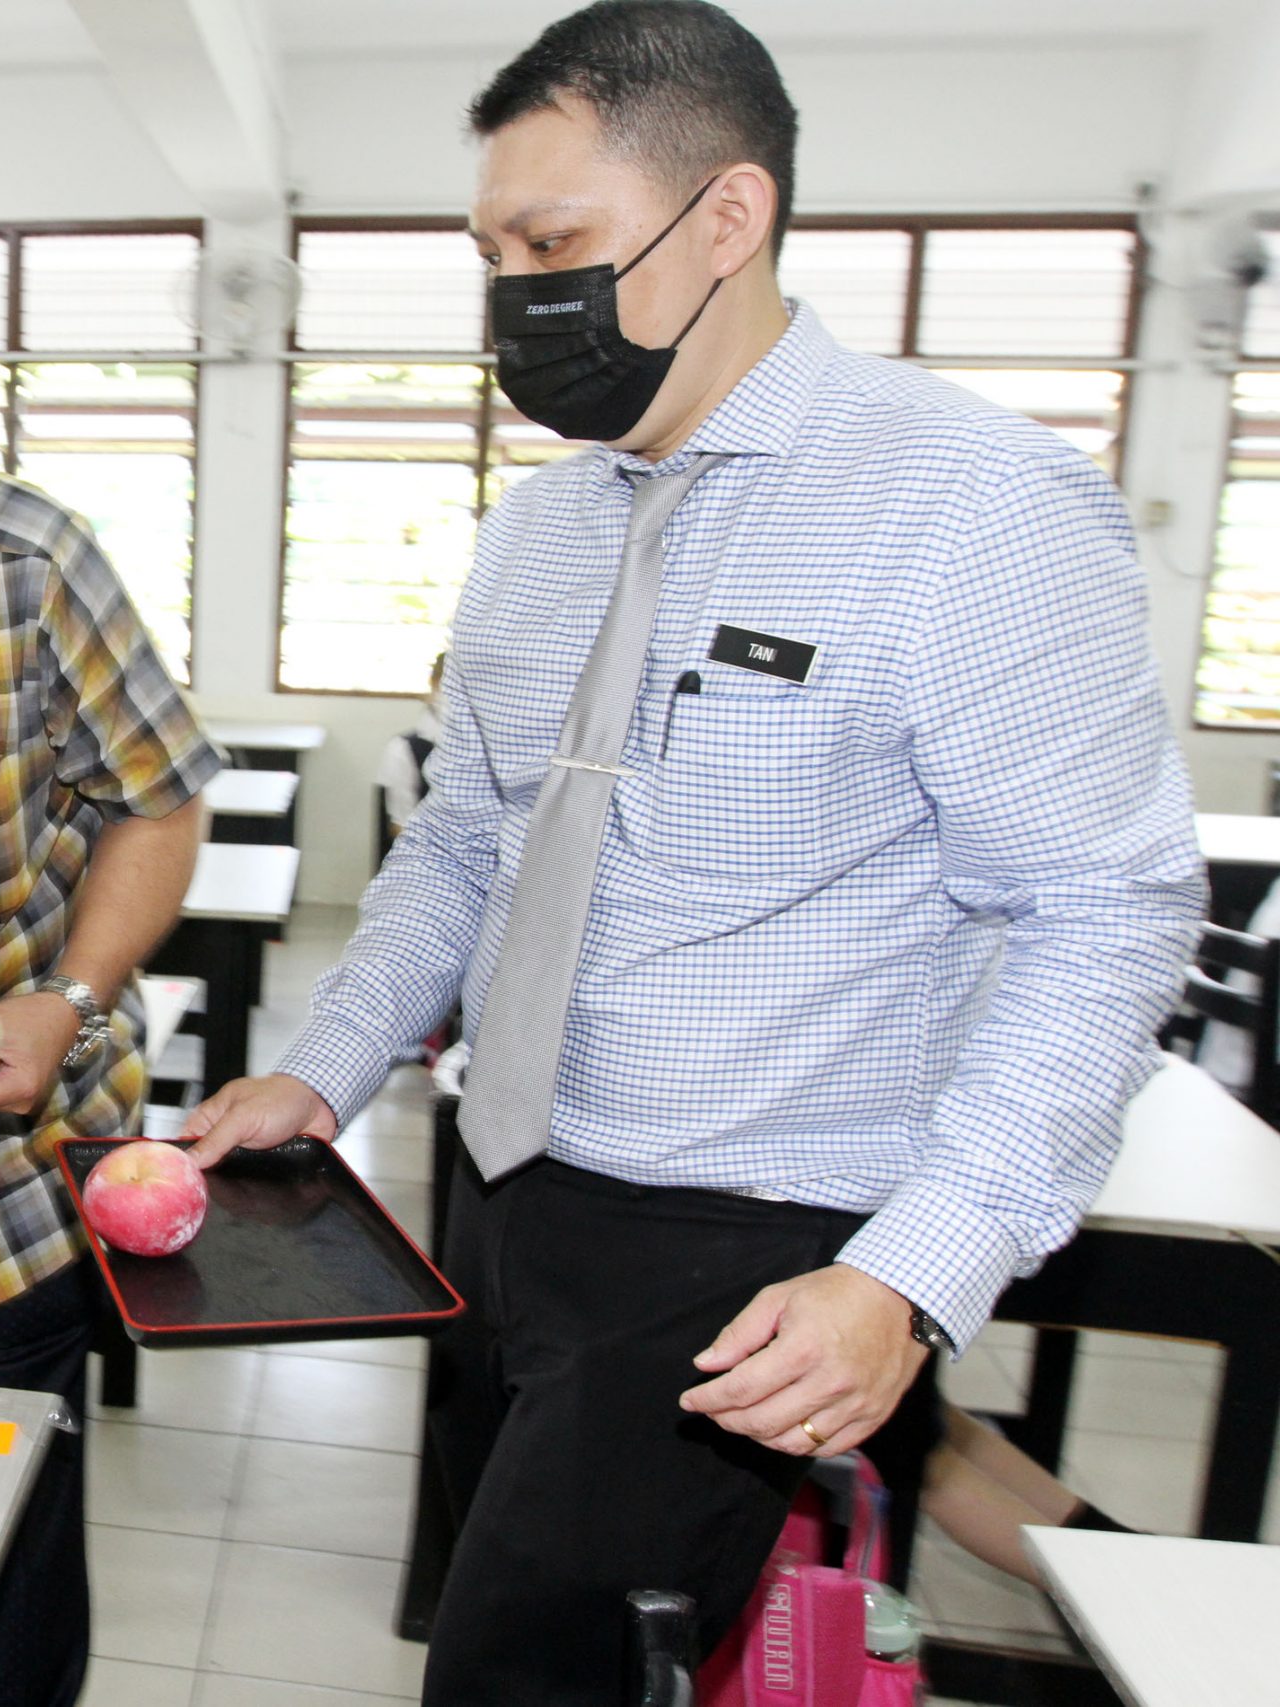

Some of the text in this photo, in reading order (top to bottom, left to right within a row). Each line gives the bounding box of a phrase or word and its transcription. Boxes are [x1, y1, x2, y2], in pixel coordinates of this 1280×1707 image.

[526, 300, 584, 315] ZERO DEGREE
[748, 643, 776, 663] TAN
